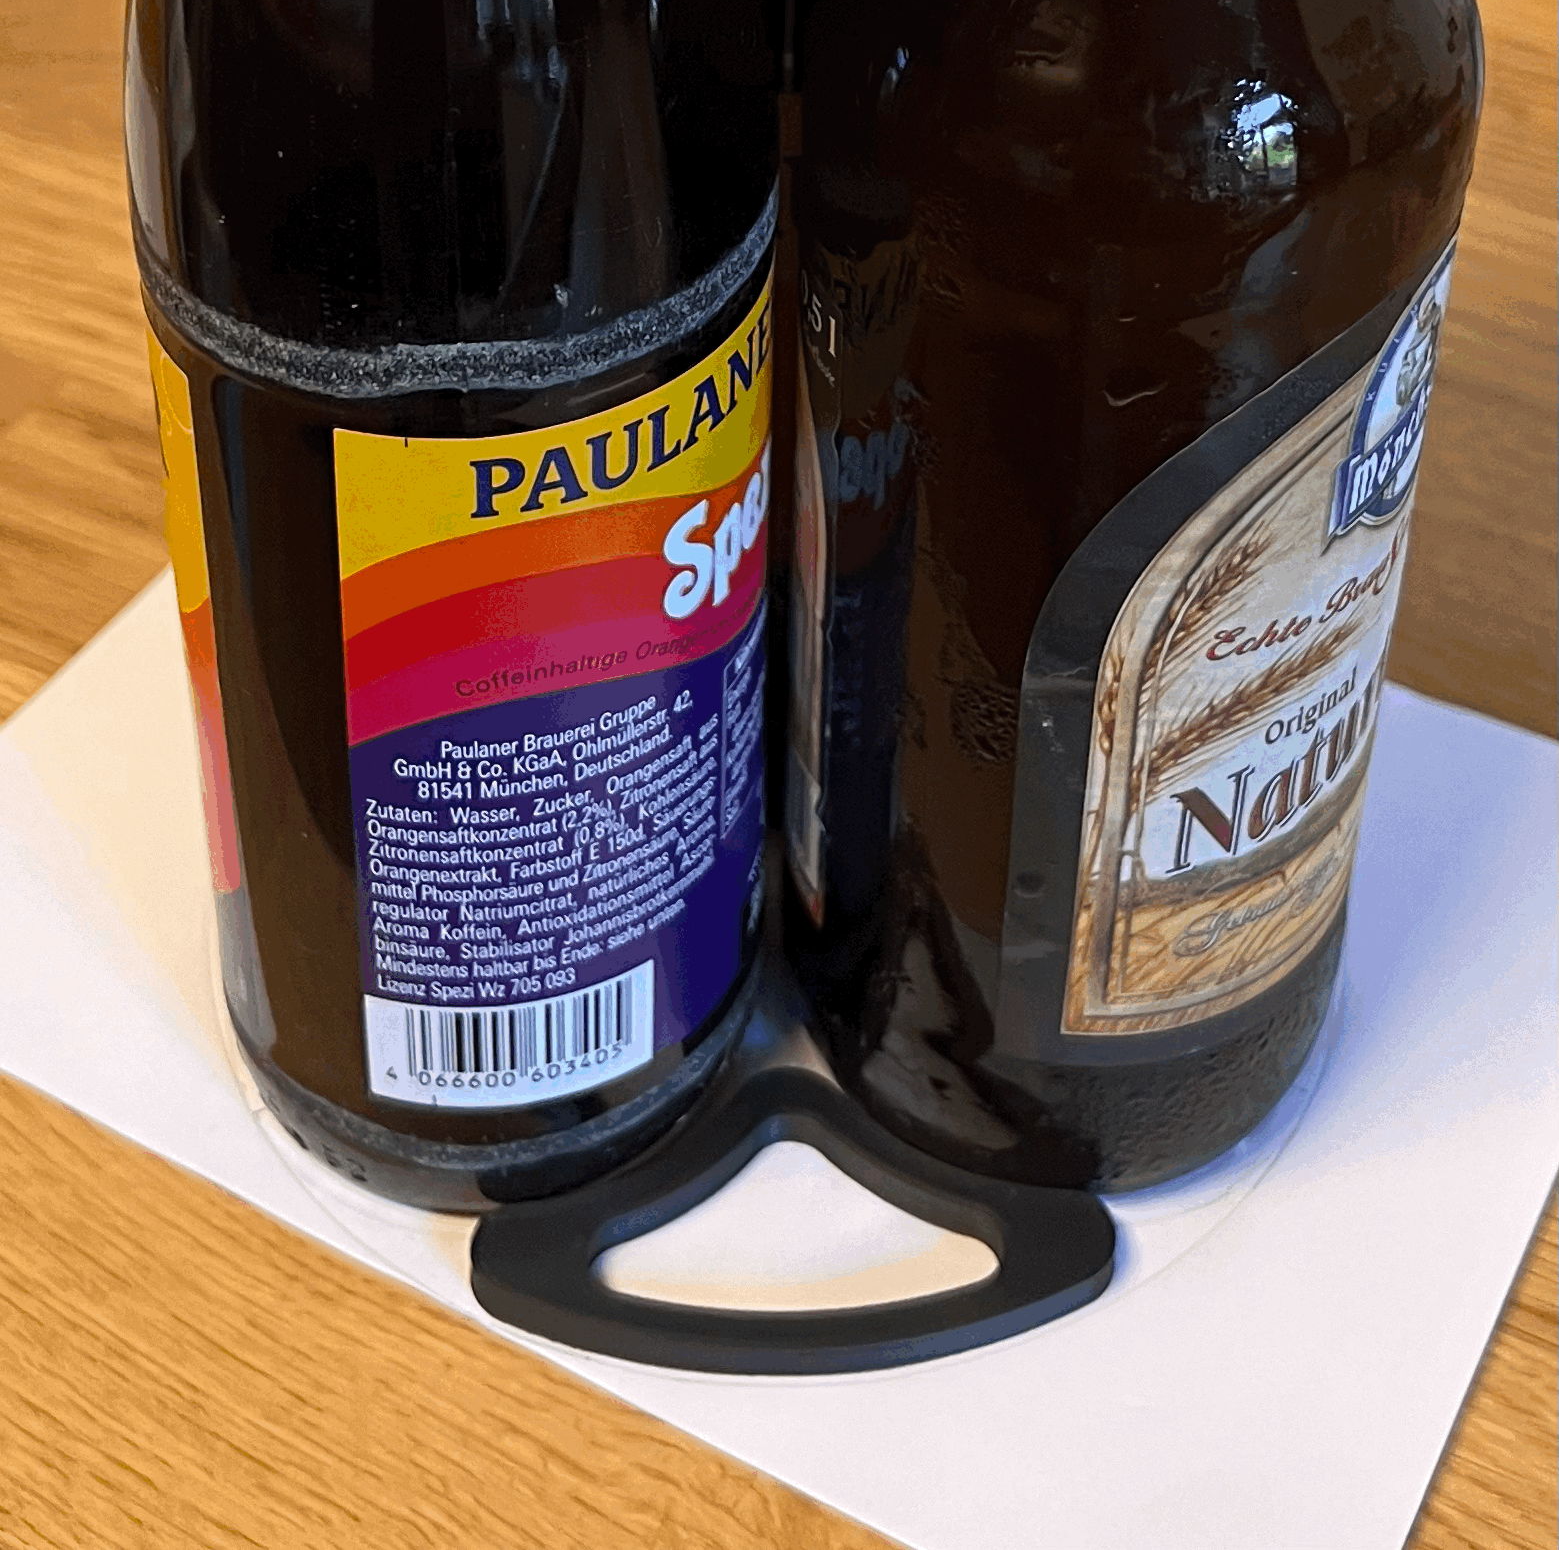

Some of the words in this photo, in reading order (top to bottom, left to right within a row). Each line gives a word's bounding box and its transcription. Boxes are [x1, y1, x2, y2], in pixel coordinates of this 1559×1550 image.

[1206, 615, 1313, 661] Echte
[455, 651, 628, 697] Coffeinhaltige
[440, 740, 519, 760] Paulaner
[523, 718, 596, 753] Brauerei
[599, 696, 657, 731] Gruppe
[1265, 663, 1358, 745] Original
[393, 758, 452, 780] GmbH
[457, 760, 472, 780] &
[477, 760, 508, 779] Co.
[572, 708, 671, 761] Ohlmüllerstr.
[417, 780, 473, 800] 81541
[480, 773, 568, 799] München,
[574, 723, 674, 782] Deutschland.
[365, 798, 438, 824] Zutaten:
[450, 806, 521, 824] Wasser,
[533, 790, 595, 816] Zucker,
[606, 734, 693, 794] Orangensaft
[367, 818, 558, 846] Orangensaftkonzentrat
[620, 750, 698, 810] Zitronensaft
[368, 836, 564, 864] Zitronensaftkonzentrat
[369, 858, 502, 885] Orangenextrakt,
[509, 847, 583, 880] Farbstoff
[589, 841, 601, 861] E
[371, 879, 417, 902] mittel
[421, 880, 545, 904] Phosphorsäure
[547, 869, 579, 892] und
[372, 900, 450, 922] regulator
[587, 851, 670, 901] natürliches
[372, 916, 430, 941] Aroma
[439, 922, 508, 941] Koffein,
[516, 862, 675, 936] Antioxidationsmittel
[373, 934, 451, 962] binsäure,
[459, 935, 556, 961] Stabilisator
[375, 952, 469, 978] Mindestens
[472, 958, 531, 978] haltbar
[533, 951, 557, 971] bis
[606, 922, 646, 951] siehe
[377, 973, 428, 998] Lizenz
[429, 980, 475, 1002] Spezi
[478, 981, 507, 998] Wz
[509, 974, 543, 996] 705
[544, 966, 577, 989] 093
[385, 1065, 399, 1081] 4
[417, 1070, 517, 1089] 066600
[530, 1041, 623, 1084] 603405
